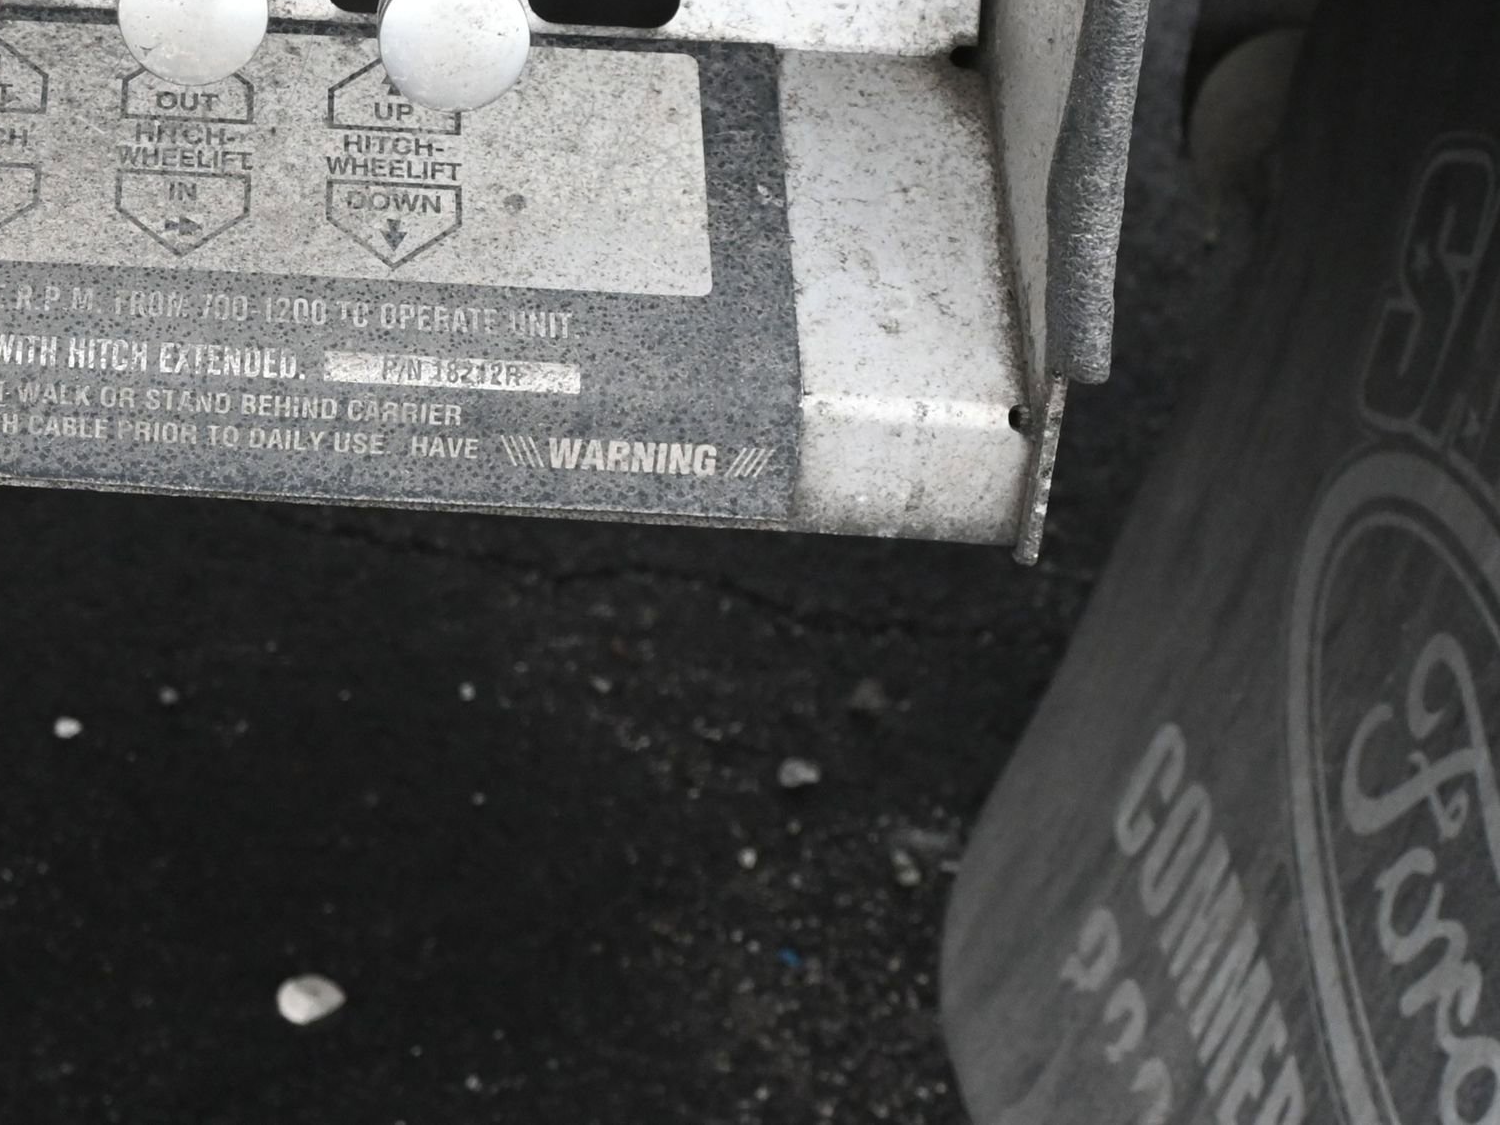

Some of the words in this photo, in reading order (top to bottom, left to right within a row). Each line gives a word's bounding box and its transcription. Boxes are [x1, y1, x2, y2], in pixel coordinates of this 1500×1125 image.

[155, 90, 220, 112] OUT
[373, 101, 414, 121] UP
[343, 133, 444, 157] HITCH-
[118, 146, 254, 171] WHEELIFT
[326, 156, 462, 181] WHEELIFT
[167, 181, 197, 202] IN
[347, 190, 442, 214] DOWN
[68, 337, 148, 373] HITCH
[18, 382, 92, 407] WALK
[100, 386, 136, 409] OR
[146, 388, 232, 415] STAND
[240, 393, 339, 420] BEHIND
[27, 414, 108, 440] CABLE
[117, 419, 198, 445] PRIOR
[209, 424, 240, 448] TO
[249, 427, 325, 453] DAILY
[410, 436, 479, 460] HAVE
[548, 437, 718, 476] WARNING
